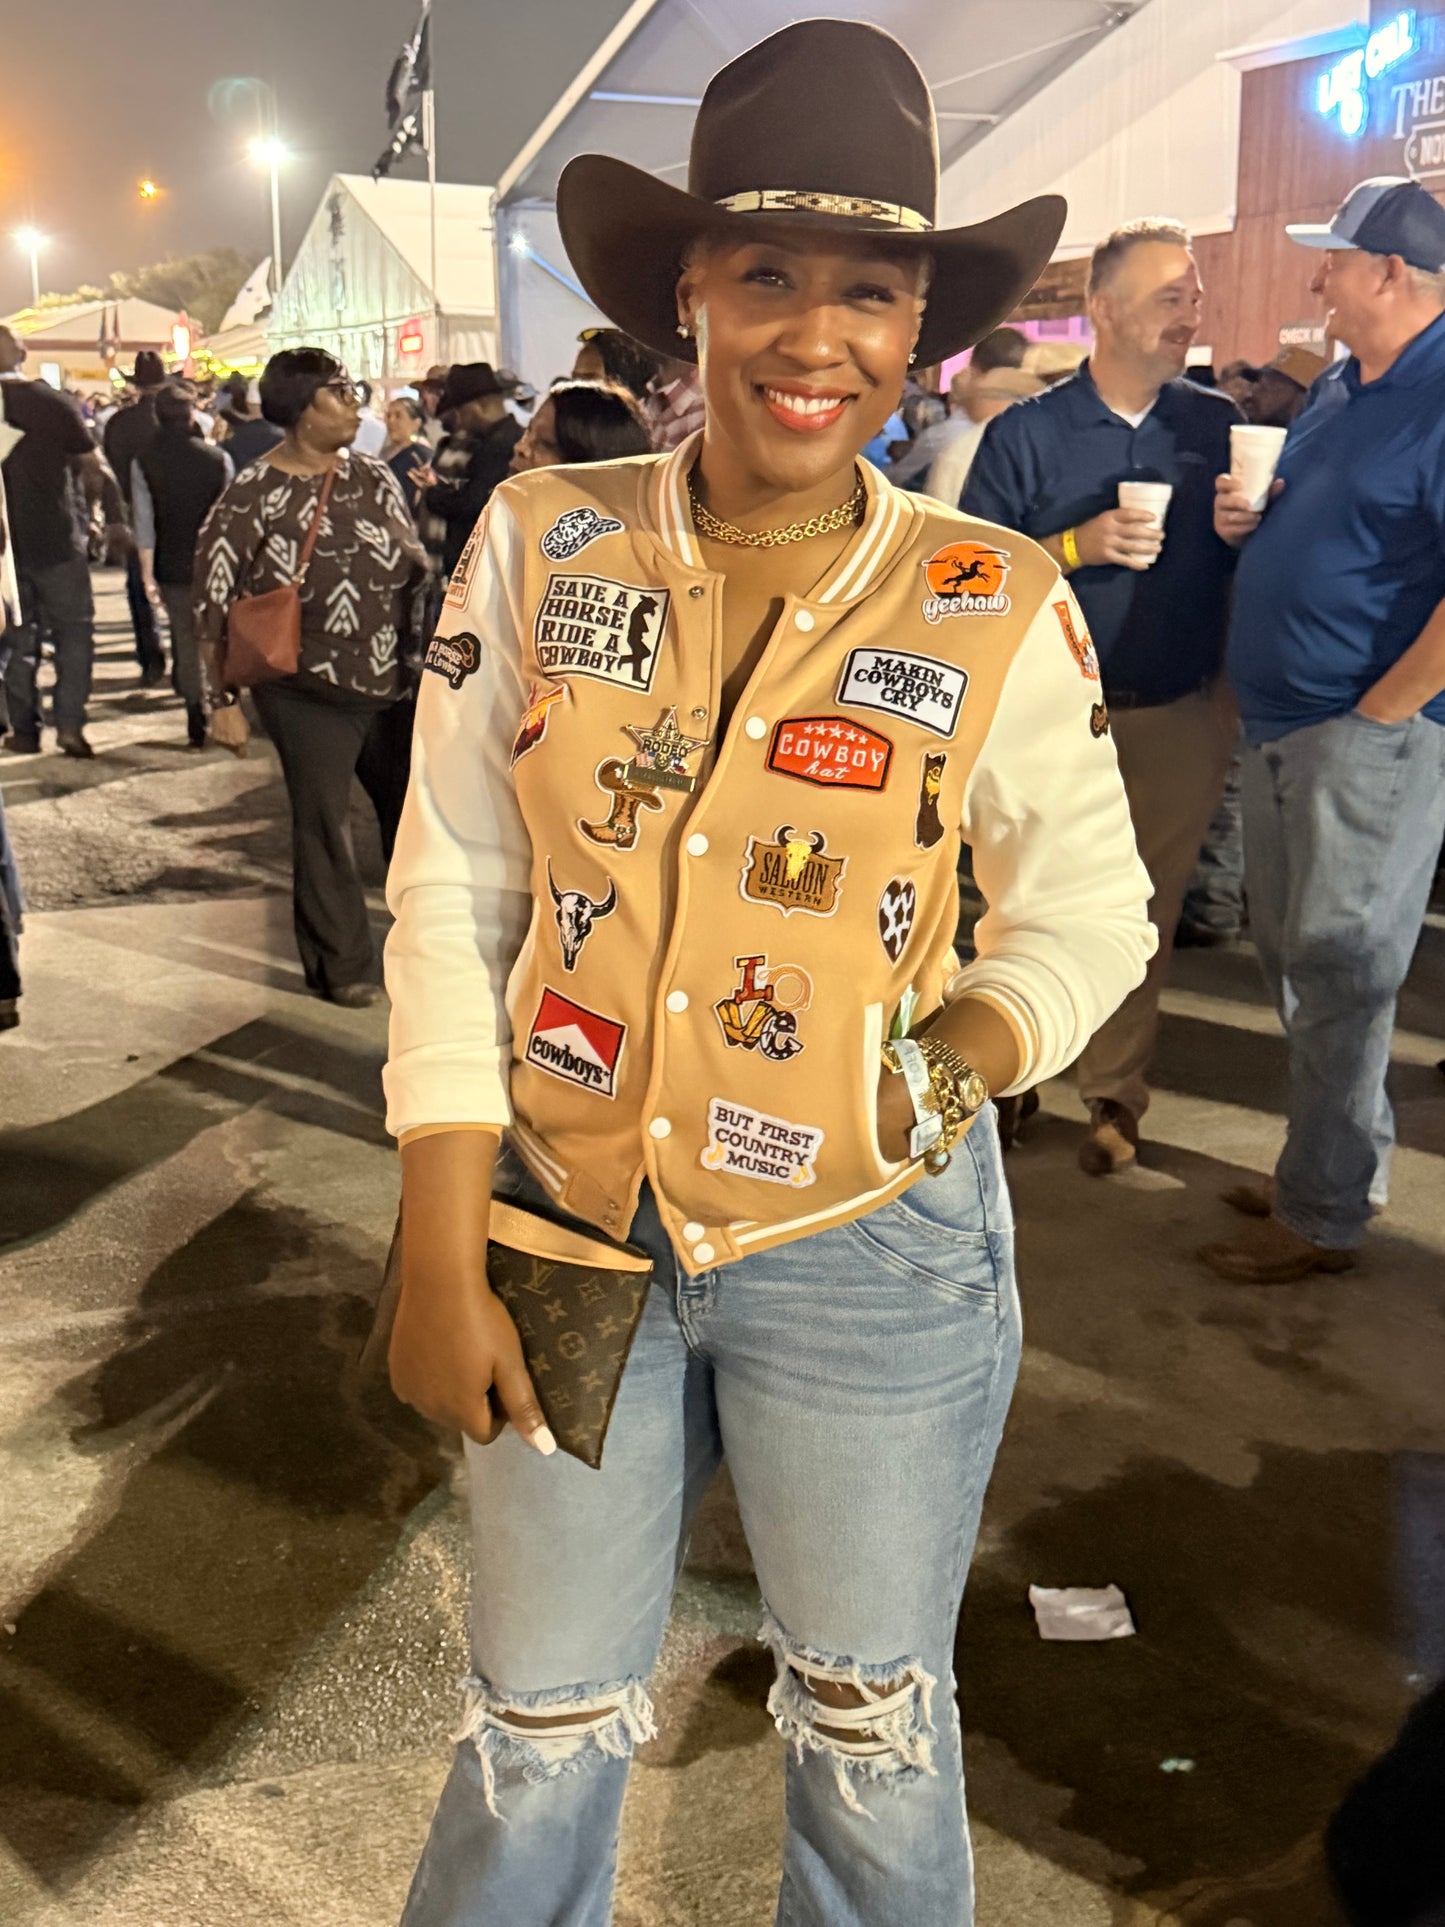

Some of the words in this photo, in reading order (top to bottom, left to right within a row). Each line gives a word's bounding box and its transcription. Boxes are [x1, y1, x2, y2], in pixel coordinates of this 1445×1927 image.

[552, 580, 607, 603] SAVE
[612, 590, 629, 609] A
[544, 599, 627, 630] HORSE
[539, 619, 597, 648] RIDE
[603, 633, 621, 654] A
[539, 645, 620, 674] COWBOY
[871, 656, 946, 687] MAKIN
[854, 668, 954, 710] COWBOYS
[880, 687, 926, 712] CRY
[642, 738, 688, 758] RODEO
[778, 733, 885, 773] COWBOY
[803, 761, 850, 780] hat
[758, 886, 822, 906] WESTERN
[714, 1106, 754, 1131] BUT
[758, 1121, 815, 1149] FIRST
[715, 1128, 809, 1167] COUNTRY
[726, 1150, 790, 1178] MUSIC
